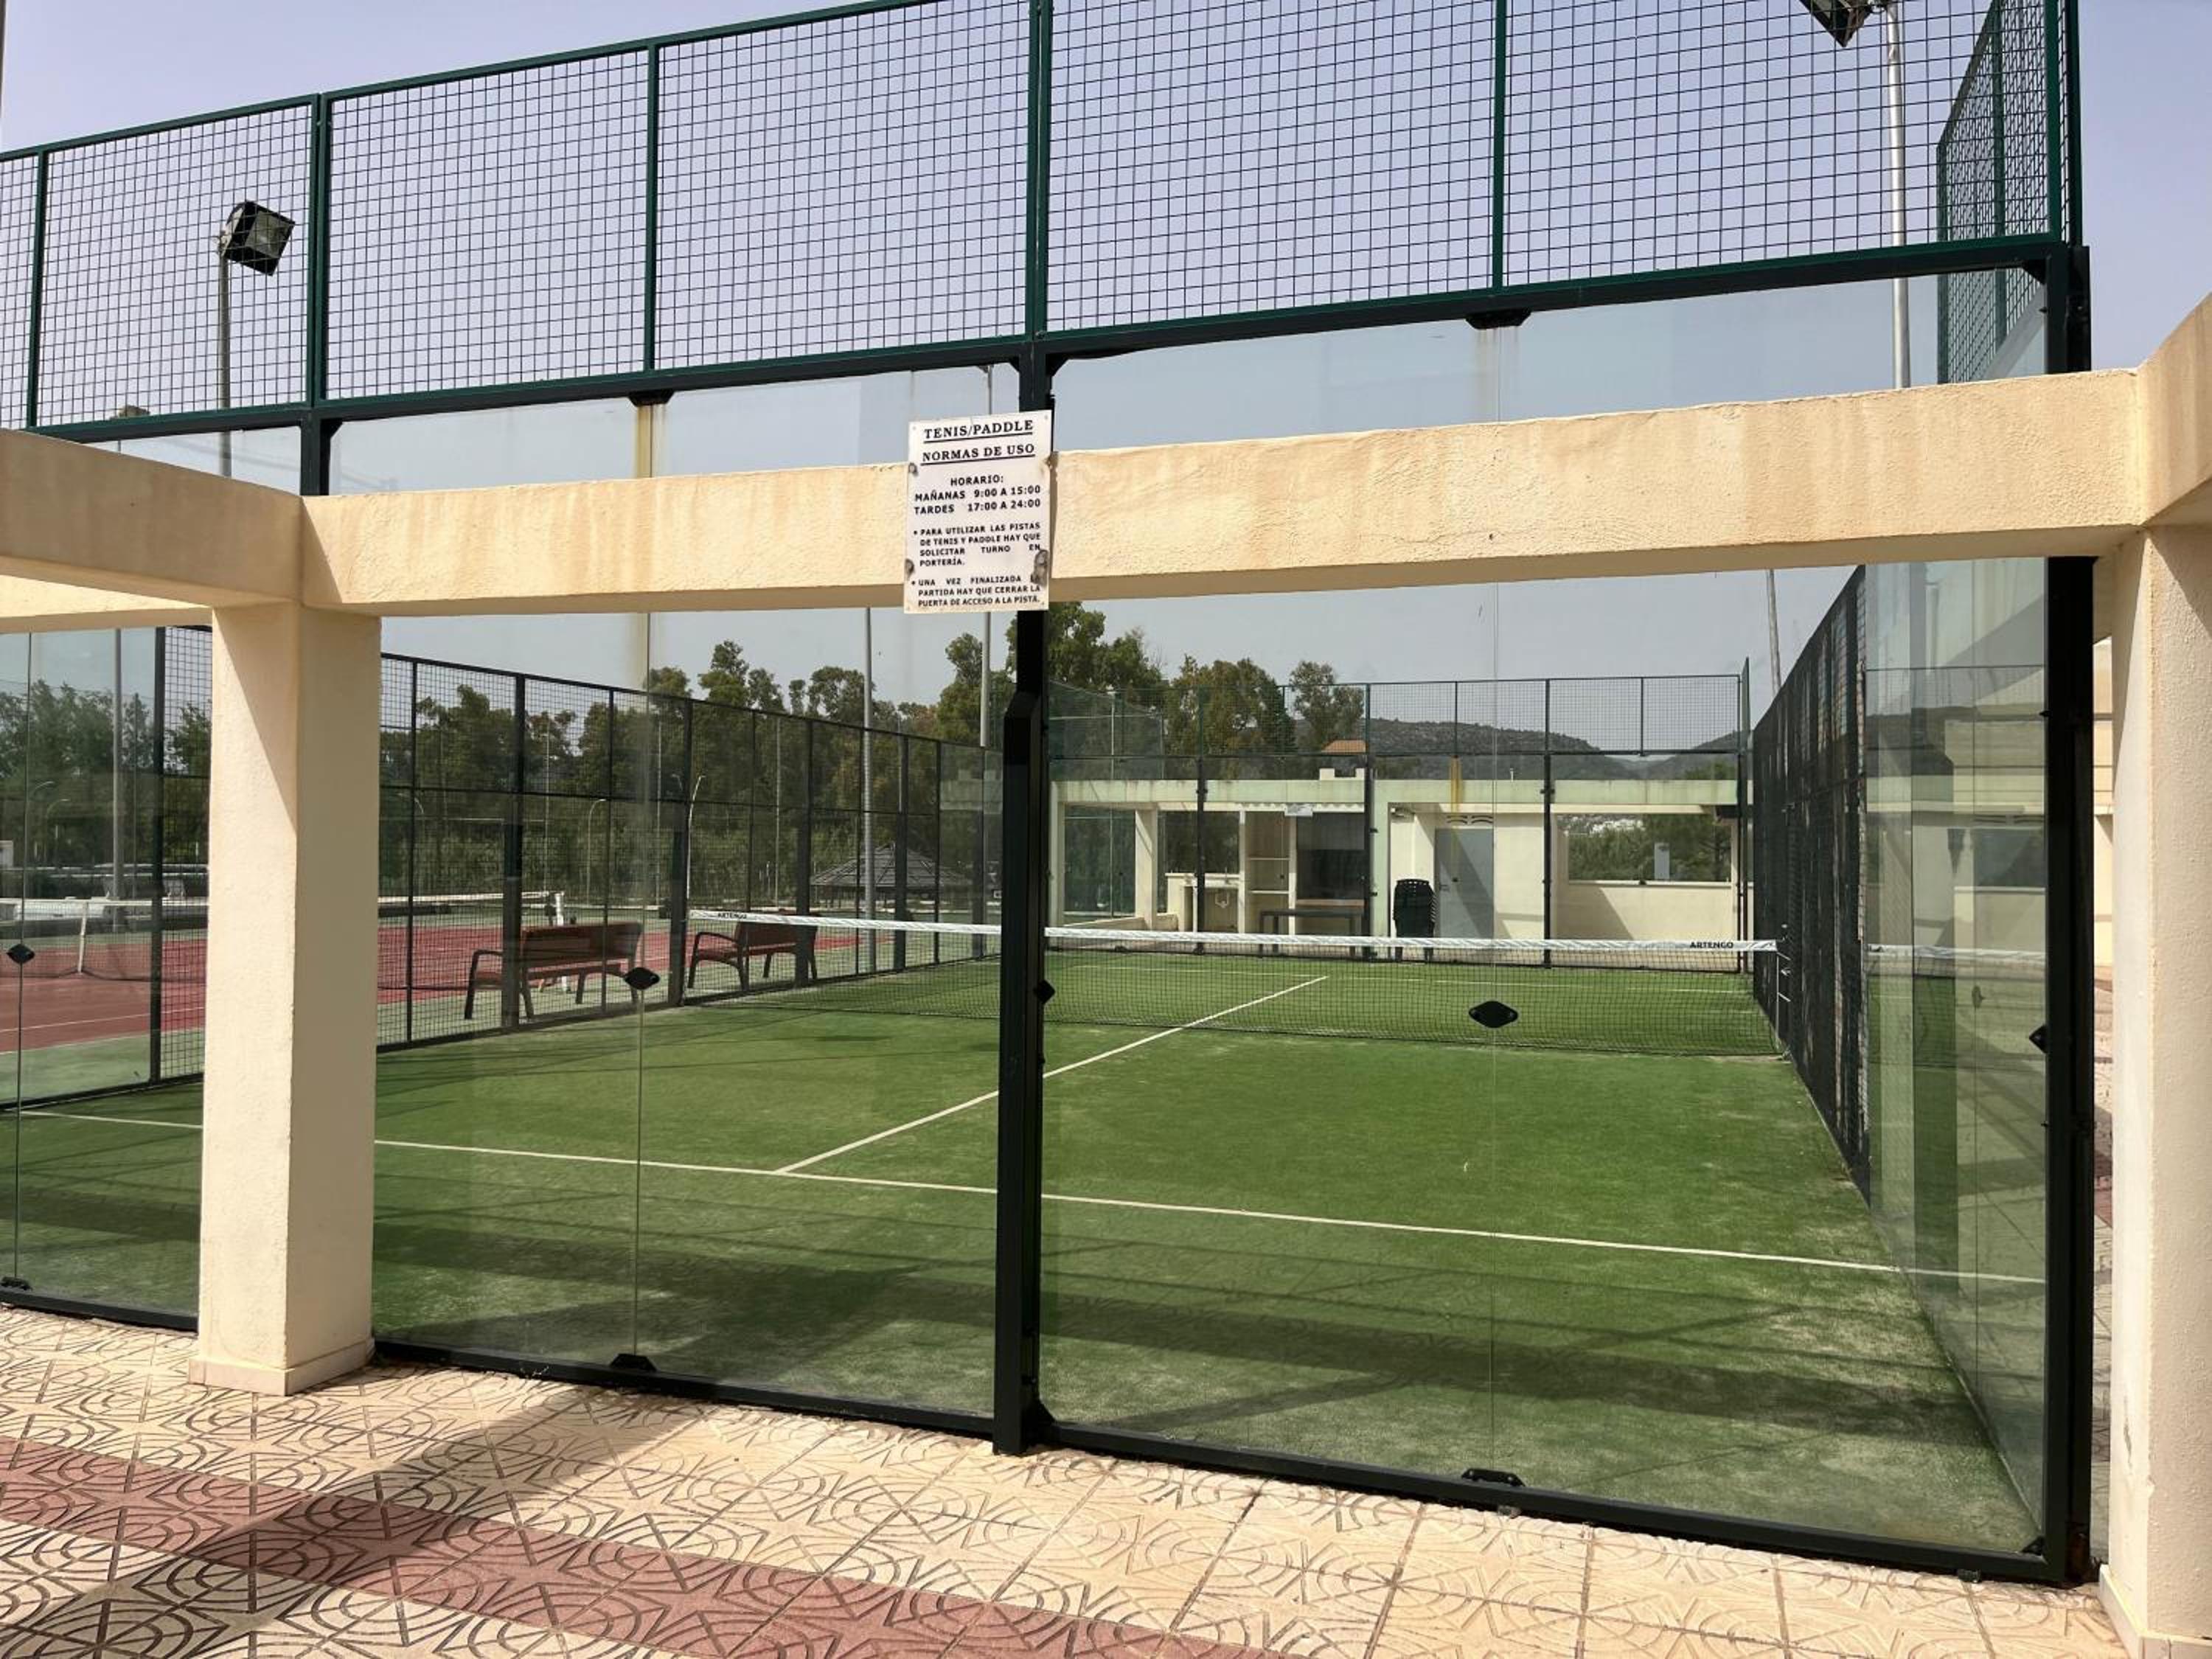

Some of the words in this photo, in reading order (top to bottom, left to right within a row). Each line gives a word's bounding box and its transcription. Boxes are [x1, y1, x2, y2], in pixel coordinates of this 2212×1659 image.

[924, 420, 1034, 439] TENIS/PADDLE
[922, 448, 979, 462] NORMAS
[984, 446, 1002, 457] DE
[1007, 443, 1034, 455] USO
[950, 475, 1004, 487] HORARIO:
[915, 490, 966, 501] MAÑANAS
[973, 488, 996, 498] 9:00
[1000, 487, 1007, 496] A
[1011, 485, 1040, 495] 15:00
[914, 504, 955, 515] TARDES
[967, 502, 996, 512] 17:00
[1000, 501, 1007, 509] A
[1011, 498, 1040, 509] 24:00
[920, 528, 942, 536] PARA
[945, 526, 986, 535] UTILIZAR
[1009, 522, 1040, 531] PISTAS
[920, 538, 931, 546] DE
[933, 538, 958, 546] TENIS
[968, 535, 1001, 543] PADDLE
[1004, 534, 1020, 542] HAY
[1023, 532, 1040, 542] QUE
[920, 548, 965, 557] SOLICITAR
[981, 546, 1011, 554] TURNO
[919, 556, 965, 567] PORTERÍA.
[970, 575, 1021, 584] FINALIZADA
[918, 588, 955, 597] PARTIDA
[956, 587, 973, 595] HAY
[975, 586, 992, 596] QUE
[995, 585, 1029, 594] CERRAR
[918, 599, 948, 607] PUERTA
[962, 597, 993, 605] ACCESO
[1014, 594, 1040, 603] PISTA.
